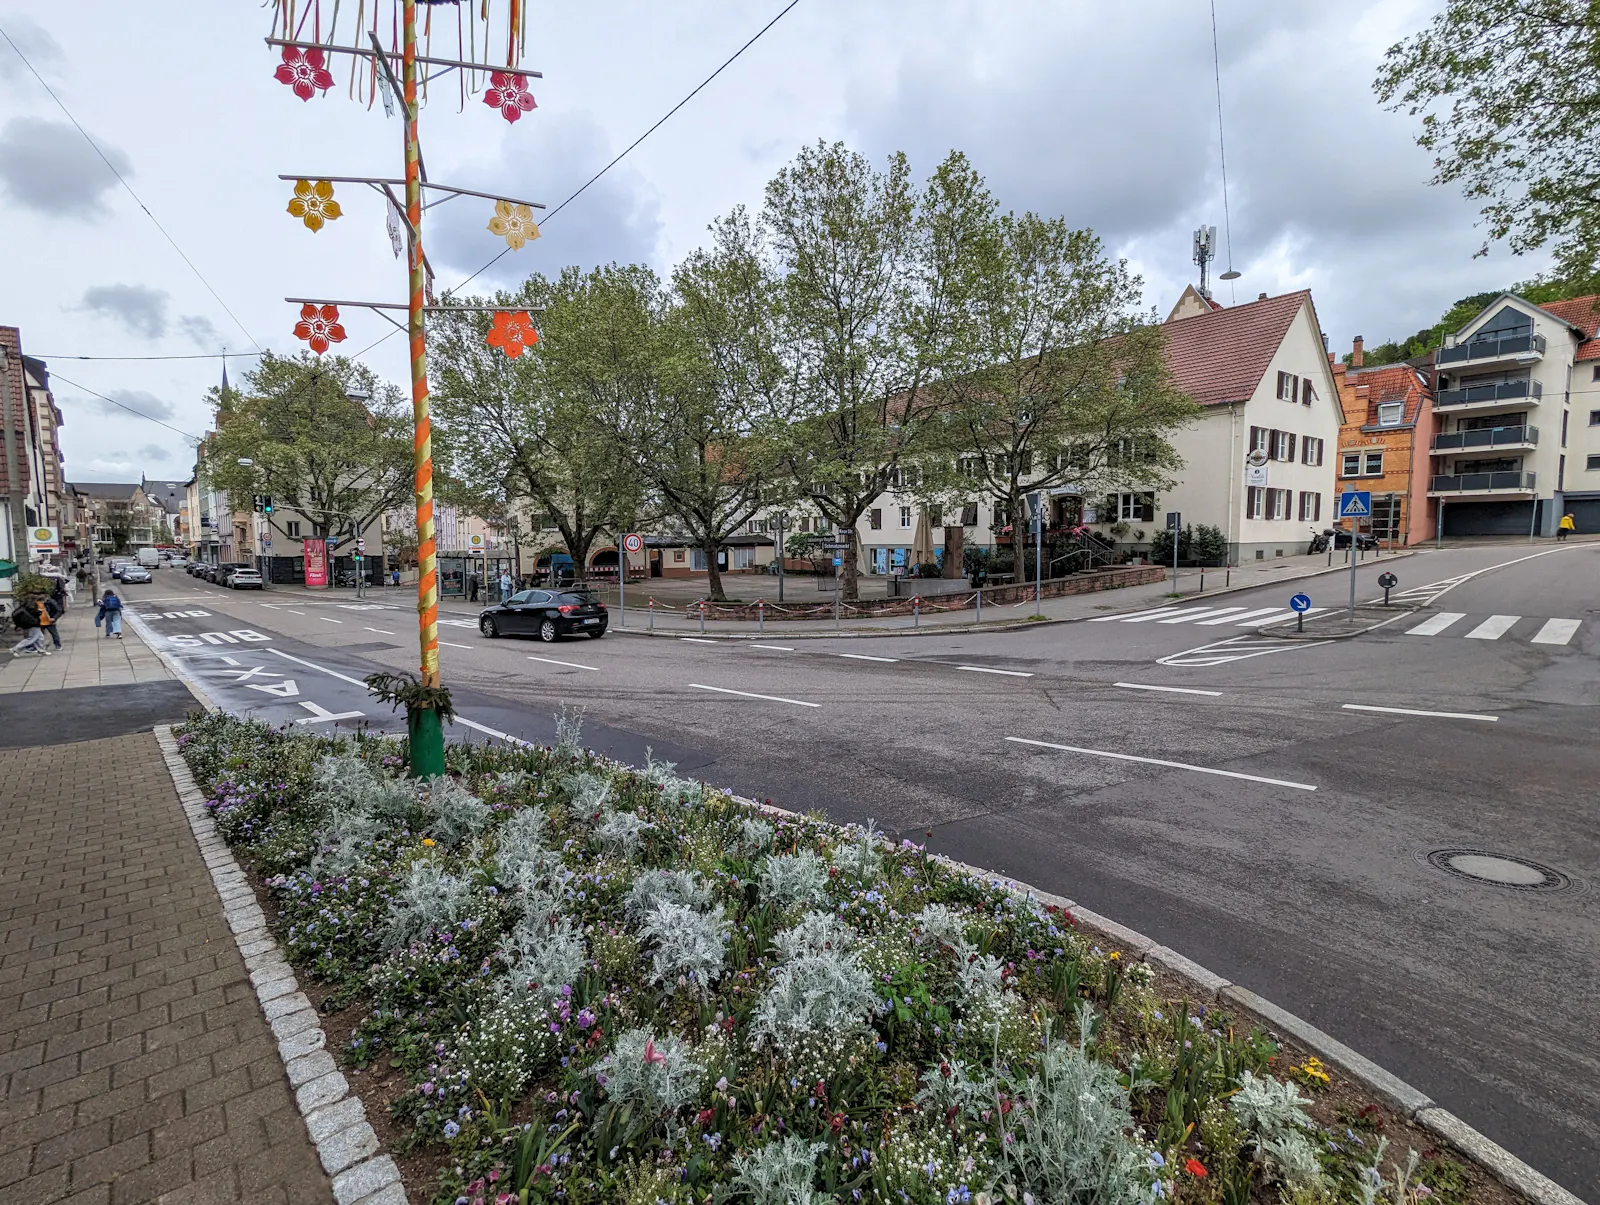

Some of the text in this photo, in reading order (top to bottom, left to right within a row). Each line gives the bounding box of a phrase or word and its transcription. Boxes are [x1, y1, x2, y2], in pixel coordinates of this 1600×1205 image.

[628, 539, 639, 548] 40
[139, 610, 212, 620] BUS
[167, 629, 273, 647] BUS
[220, 656, 366, 725] TAXI
